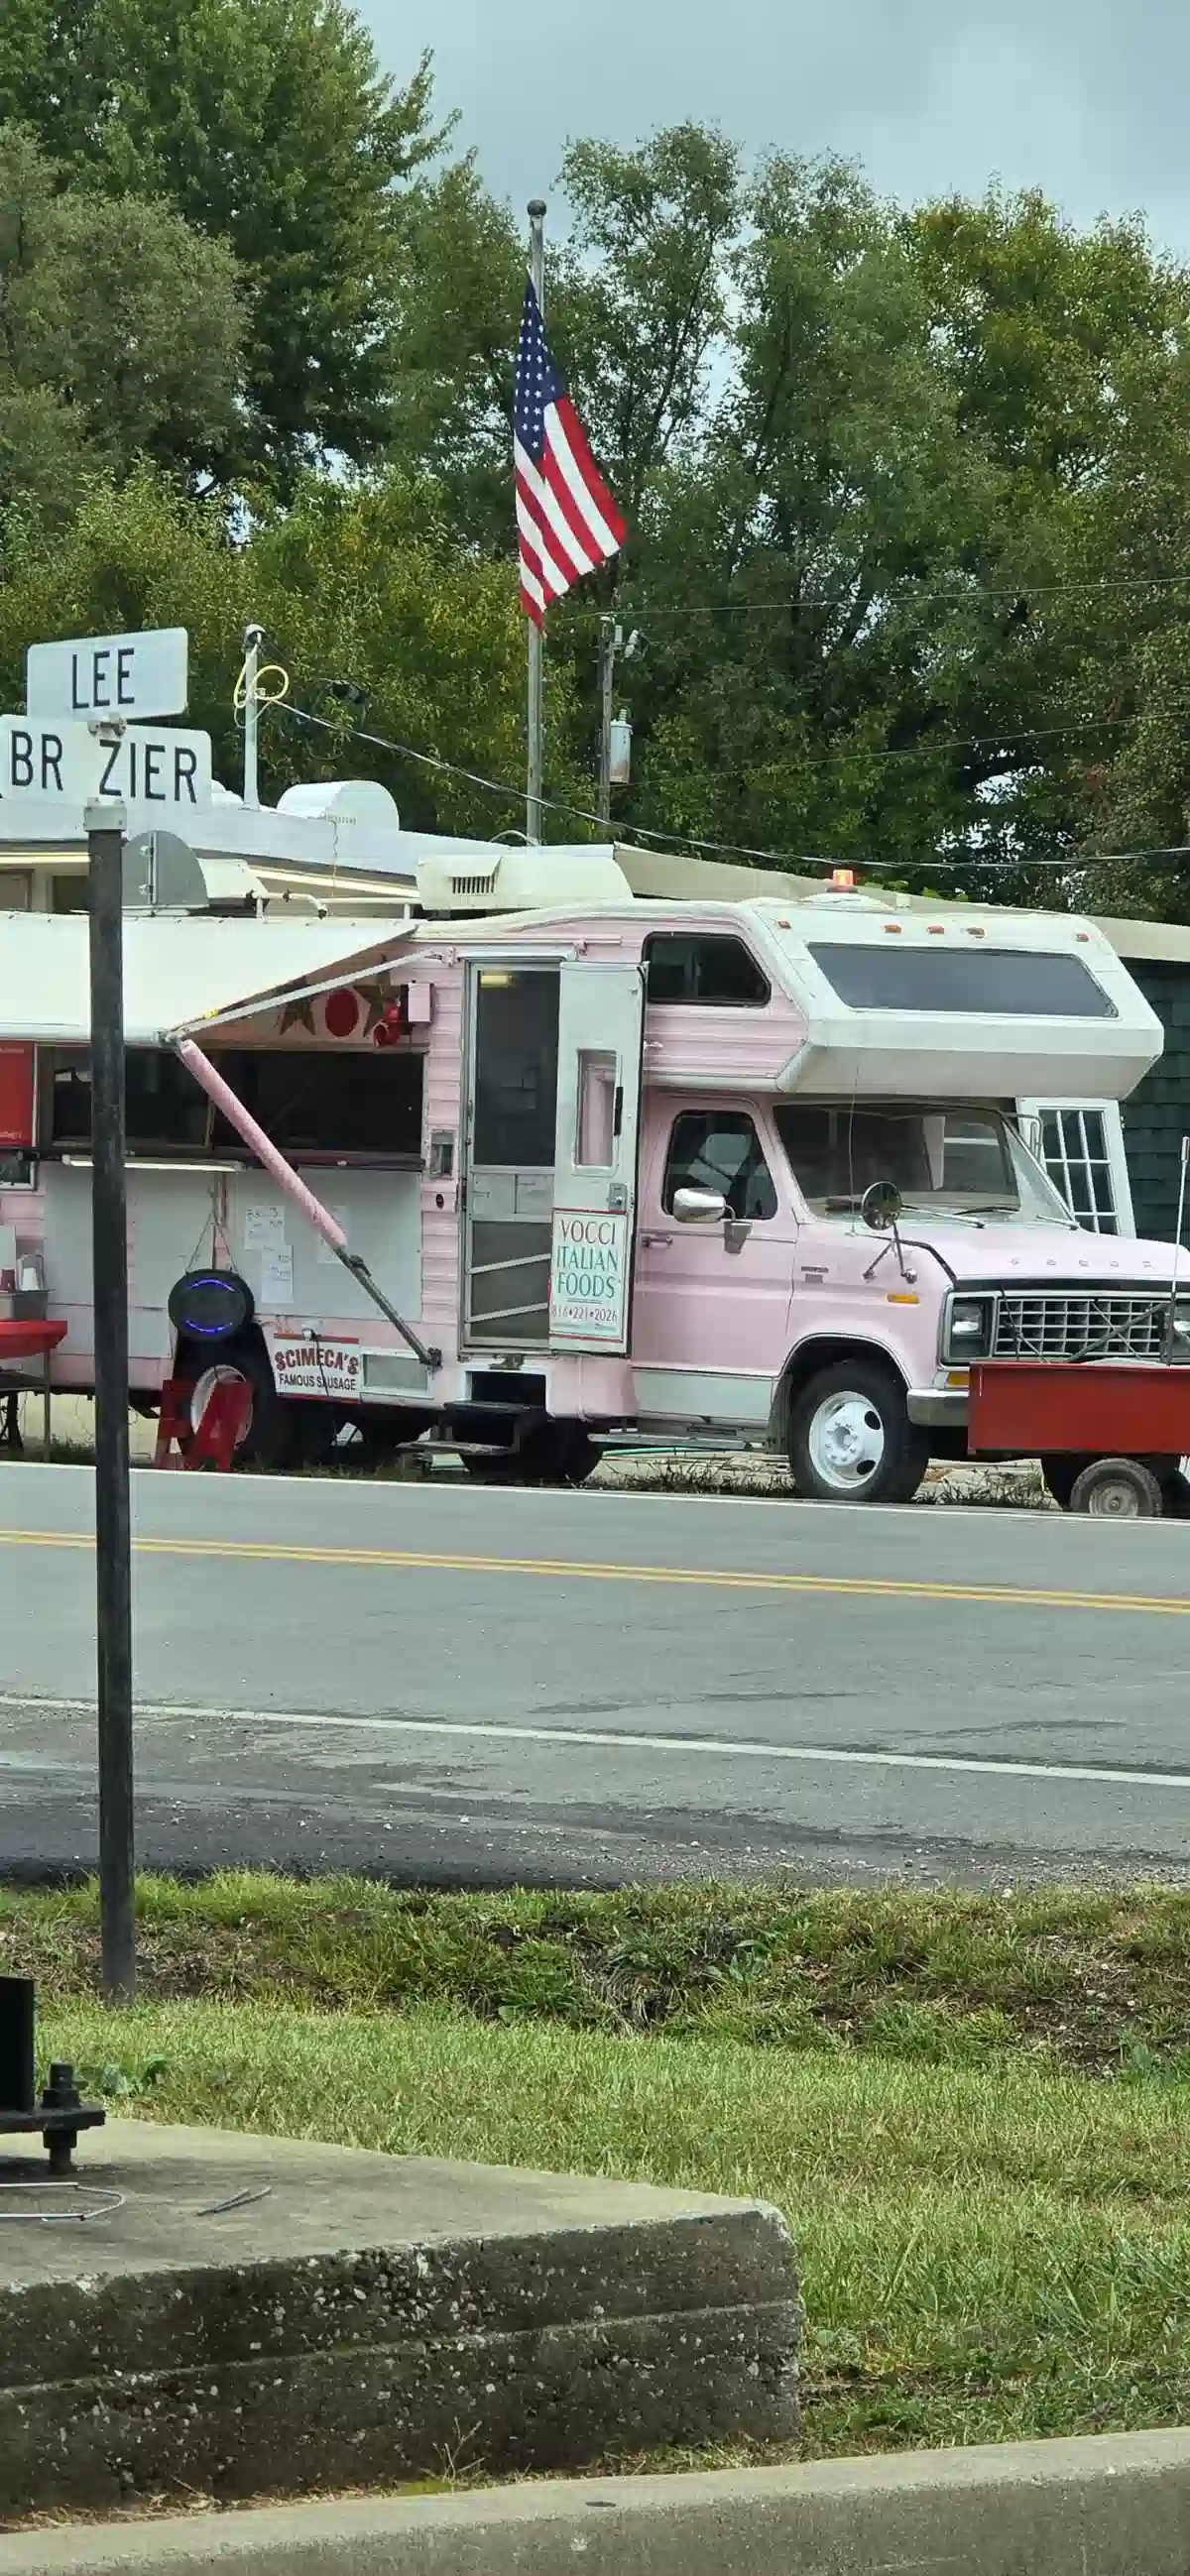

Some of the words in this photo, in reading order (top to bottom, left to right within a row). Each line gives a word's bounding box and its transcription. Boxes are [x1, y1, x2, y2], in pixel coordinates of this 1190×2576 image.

[71, 647, 135, 710] LEE
[561, 1219, 616, 1245] VOCCI
[556, 1244, 618, 1272] ITALIAN
[557, 1271, 616, 1299] FOODS
[275, 1348, 359, 1375] SCIMECA'S
[279, 1372, 315, 1388] FAMOUS
[316, 1375, 357, 1391] SAUSAGE
